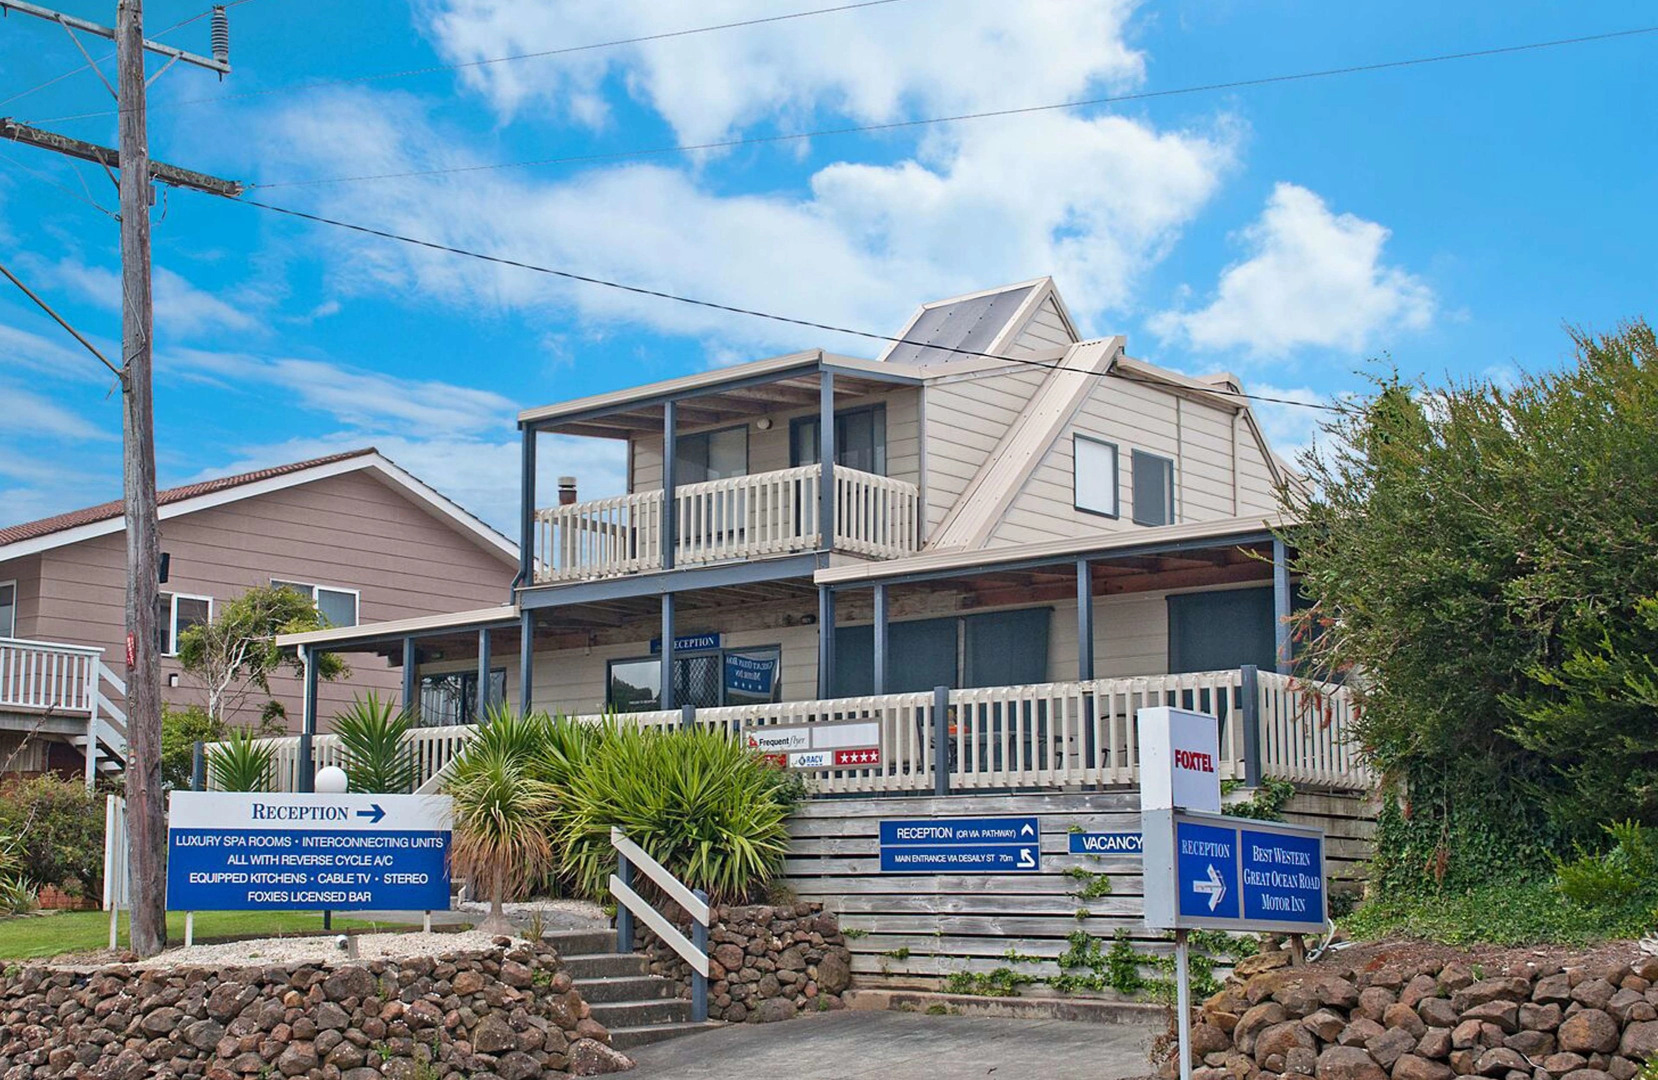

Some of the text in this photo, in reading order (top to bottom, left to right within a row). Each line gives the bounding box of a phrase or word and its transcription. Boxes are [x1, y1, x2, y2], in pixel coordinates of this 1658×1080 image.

[674, 637, 714, 649] ECEPTION
[759, 736, 805, 747] Frequent flyer
[806, 755, 824, 763] RACV
[1175, 749, 1214, 773] FOXTEL
[252, 803, 349, 821] RECEPTION
[897, 828, 1016, 839] RECEPTION (OR VIA PATHWAY)
[176, 835, 444, 848] LUXURY SPA ROOMS INTERCONNECTING UNITS
[1082, 836, 1143, 850] VACANCY
[1181, 839, 1230, 858] RECEPTION
[227, 855, 393, 866] ALL WITH REVERSE CYCLE A/C
[894, 853, 1013, 863] MAIN ENTRANCE VIA DESAILY ST 70m
[1253, 845, 1311, 866] BEST WESTERN
[189, 872, 428, 884] EQUIPPED KITCHENS CABLE TV STEREO
[1243, 867, 1321, 890] GREAT OCEAN ROAD
[248, 891, 372, 902] FOXIES LICENSED BAR
[1262, 893, 1306, 912] MOTOR INN
